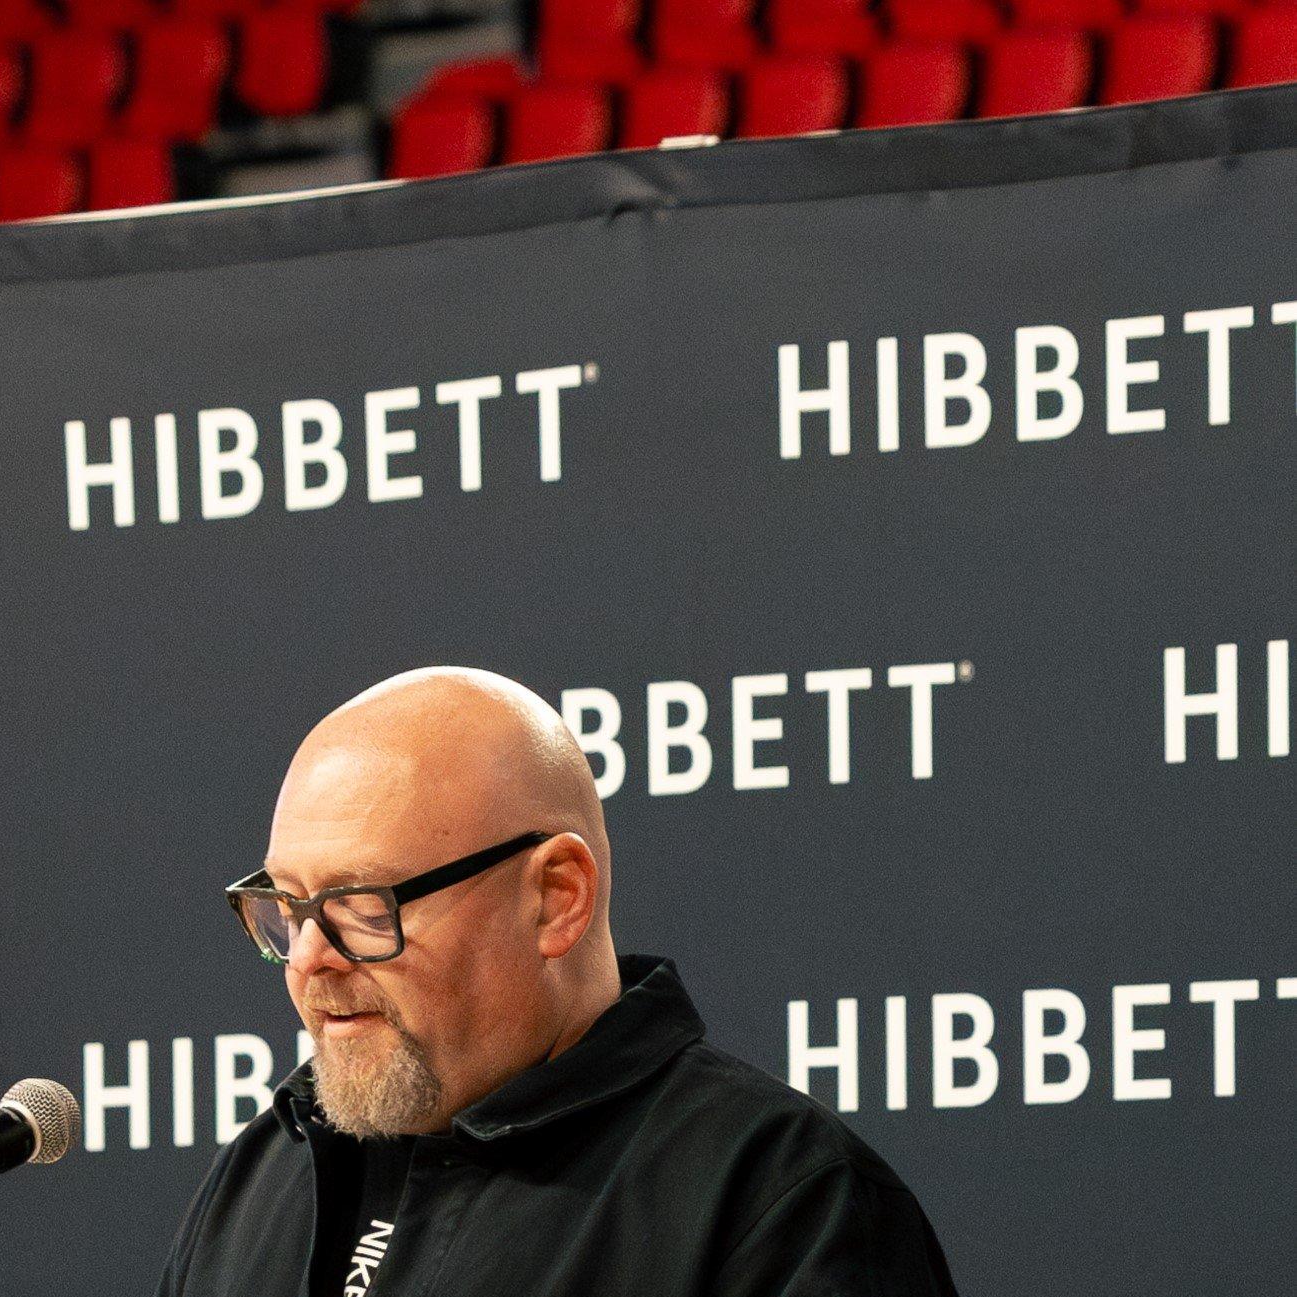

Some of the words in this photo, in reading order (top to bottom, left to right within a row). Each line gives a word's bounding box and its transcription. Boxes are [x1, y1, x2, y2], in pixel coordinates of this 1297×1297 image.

[64, 364, 584, 530] HIBBETT
[778, 301, 1297, 460] HIBBET
[787, 977, 1297, 1113] HIBBET
